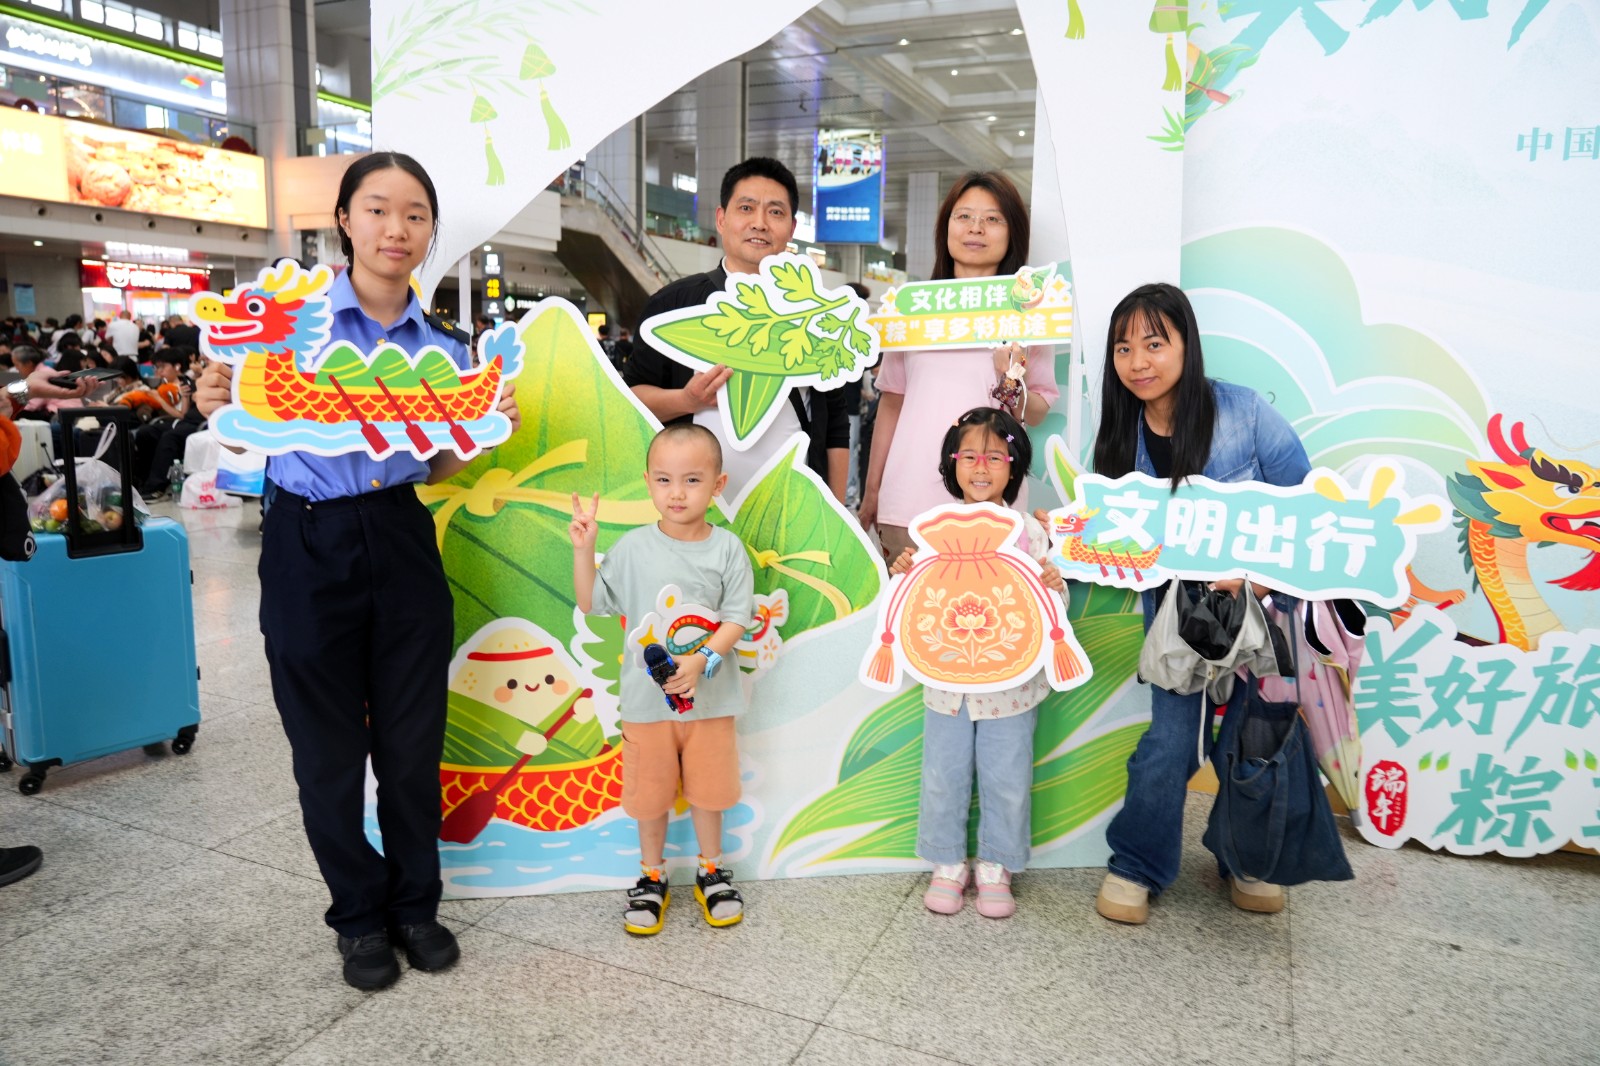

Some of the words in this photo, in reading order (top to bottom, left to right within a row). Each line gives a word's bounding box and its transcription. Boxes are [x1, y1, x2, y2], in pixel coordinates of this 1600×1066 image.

[1516, 125, 1600, 162] 中国
[910, 284, 1008, 313] 文化相伴
[1097, 490, 1377, 578] 文明出行
